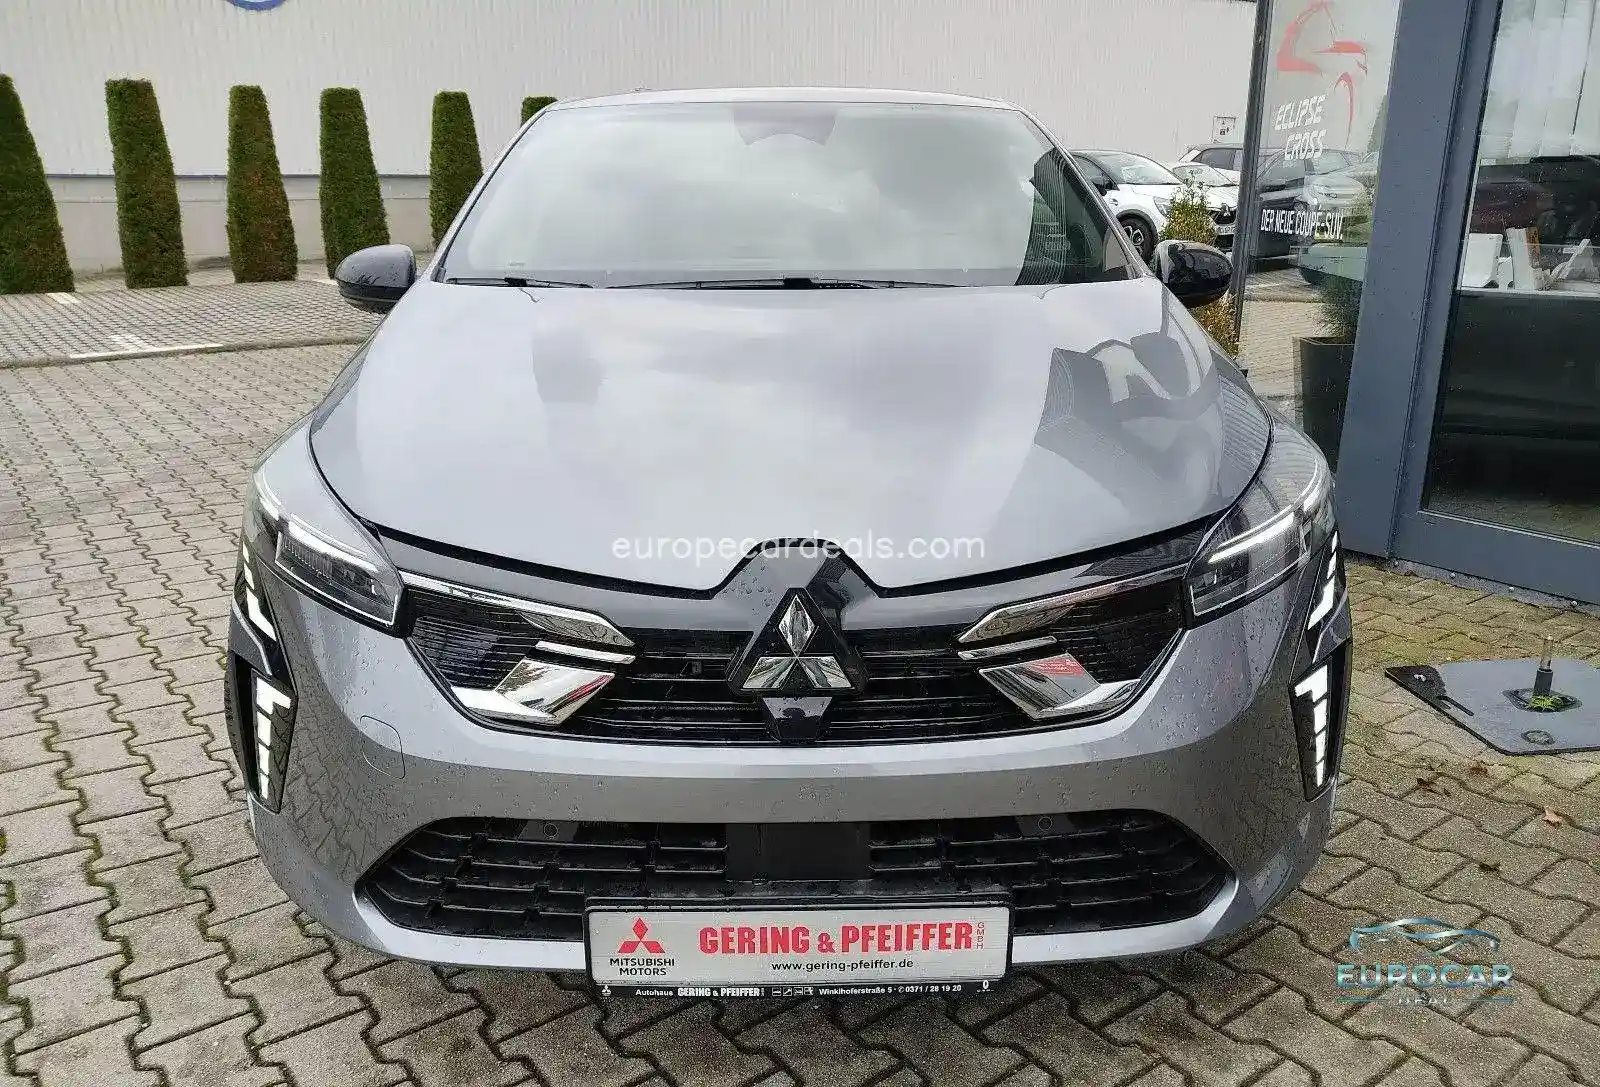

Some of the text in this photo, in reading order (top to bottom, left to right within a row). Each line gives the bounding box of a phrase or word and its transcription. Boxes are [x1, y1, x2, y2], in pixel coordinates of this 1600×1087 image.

[1274, 94, 1327, 131] ECLIPSE
[1284, 129, 1327, 161] CROSS
[1260, 209, 1274, 232] DER
[1275, 209, 1295, 235] NEUE
[699, 922, 973, 955] GERING & PFEIFFER
[609, 958, 675, 967] MITSUBISHI
[771, 959, 914, 973] www.gering-pfeiffer.de
[619, 967, 667, 976] MOTORS
[635, 988, 674, 997] Autohaus
[677, 987, 712, 997] GERING
[720, 987, 760, 997] PFEIFFER
[818, 986, 886, 996] Winklhoferstraße
[887, 986, 893, 994] 5
[905, 985, 925, 994] 0371
[930, 985, 939, 994] 28
[941, 984, 951, 993] 19
[952, 984, 962, 993] 20
